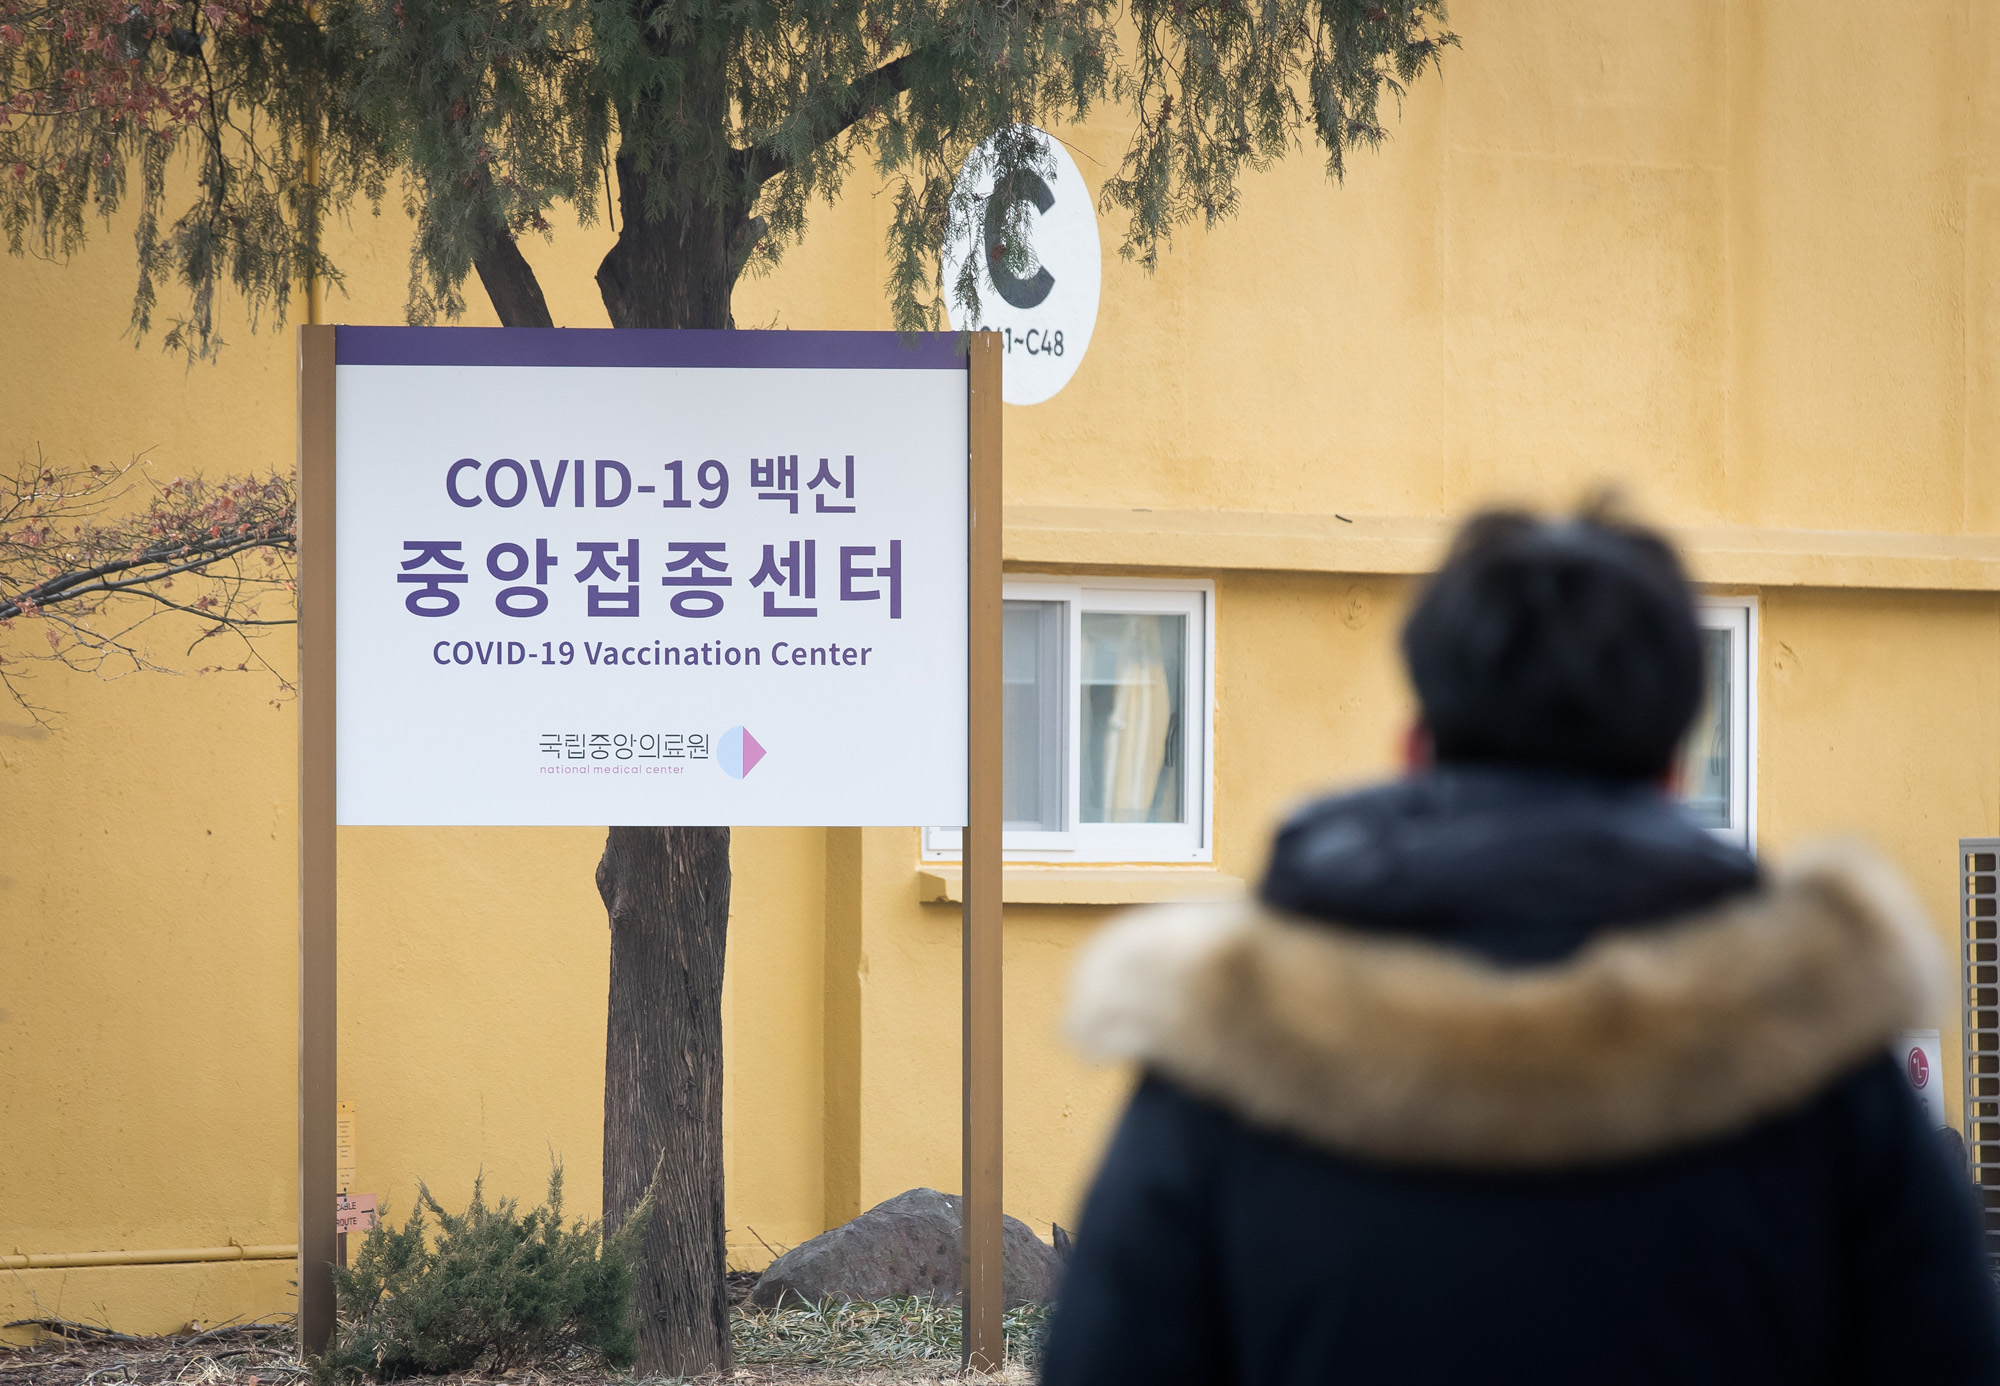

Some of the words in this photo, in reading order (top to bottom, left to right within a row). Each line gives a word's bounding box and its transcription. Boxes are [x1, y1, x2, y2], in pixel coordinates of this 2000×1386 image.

[985, 168, 1056, 309] C
[980, 325, 1064, 357] 1~C48
[446, 457, 730, 510] COVID-19
[750, 455, 857, 515] 백신
[396, 537, 902, 620] 중앙접종센터
[433, 641, 575, 666] COVID-19
[583, 640, 761, 667] Vaccination
[771, 642, 873, 667] Center
[539, 733, 709, 760] 국립중앙의료원
[540, 764, 590, 774] national
[593, 764, 642, 774] medical
[645, 765, 685, 775] center
[336, 1216, 357, 1227] ROUTE
